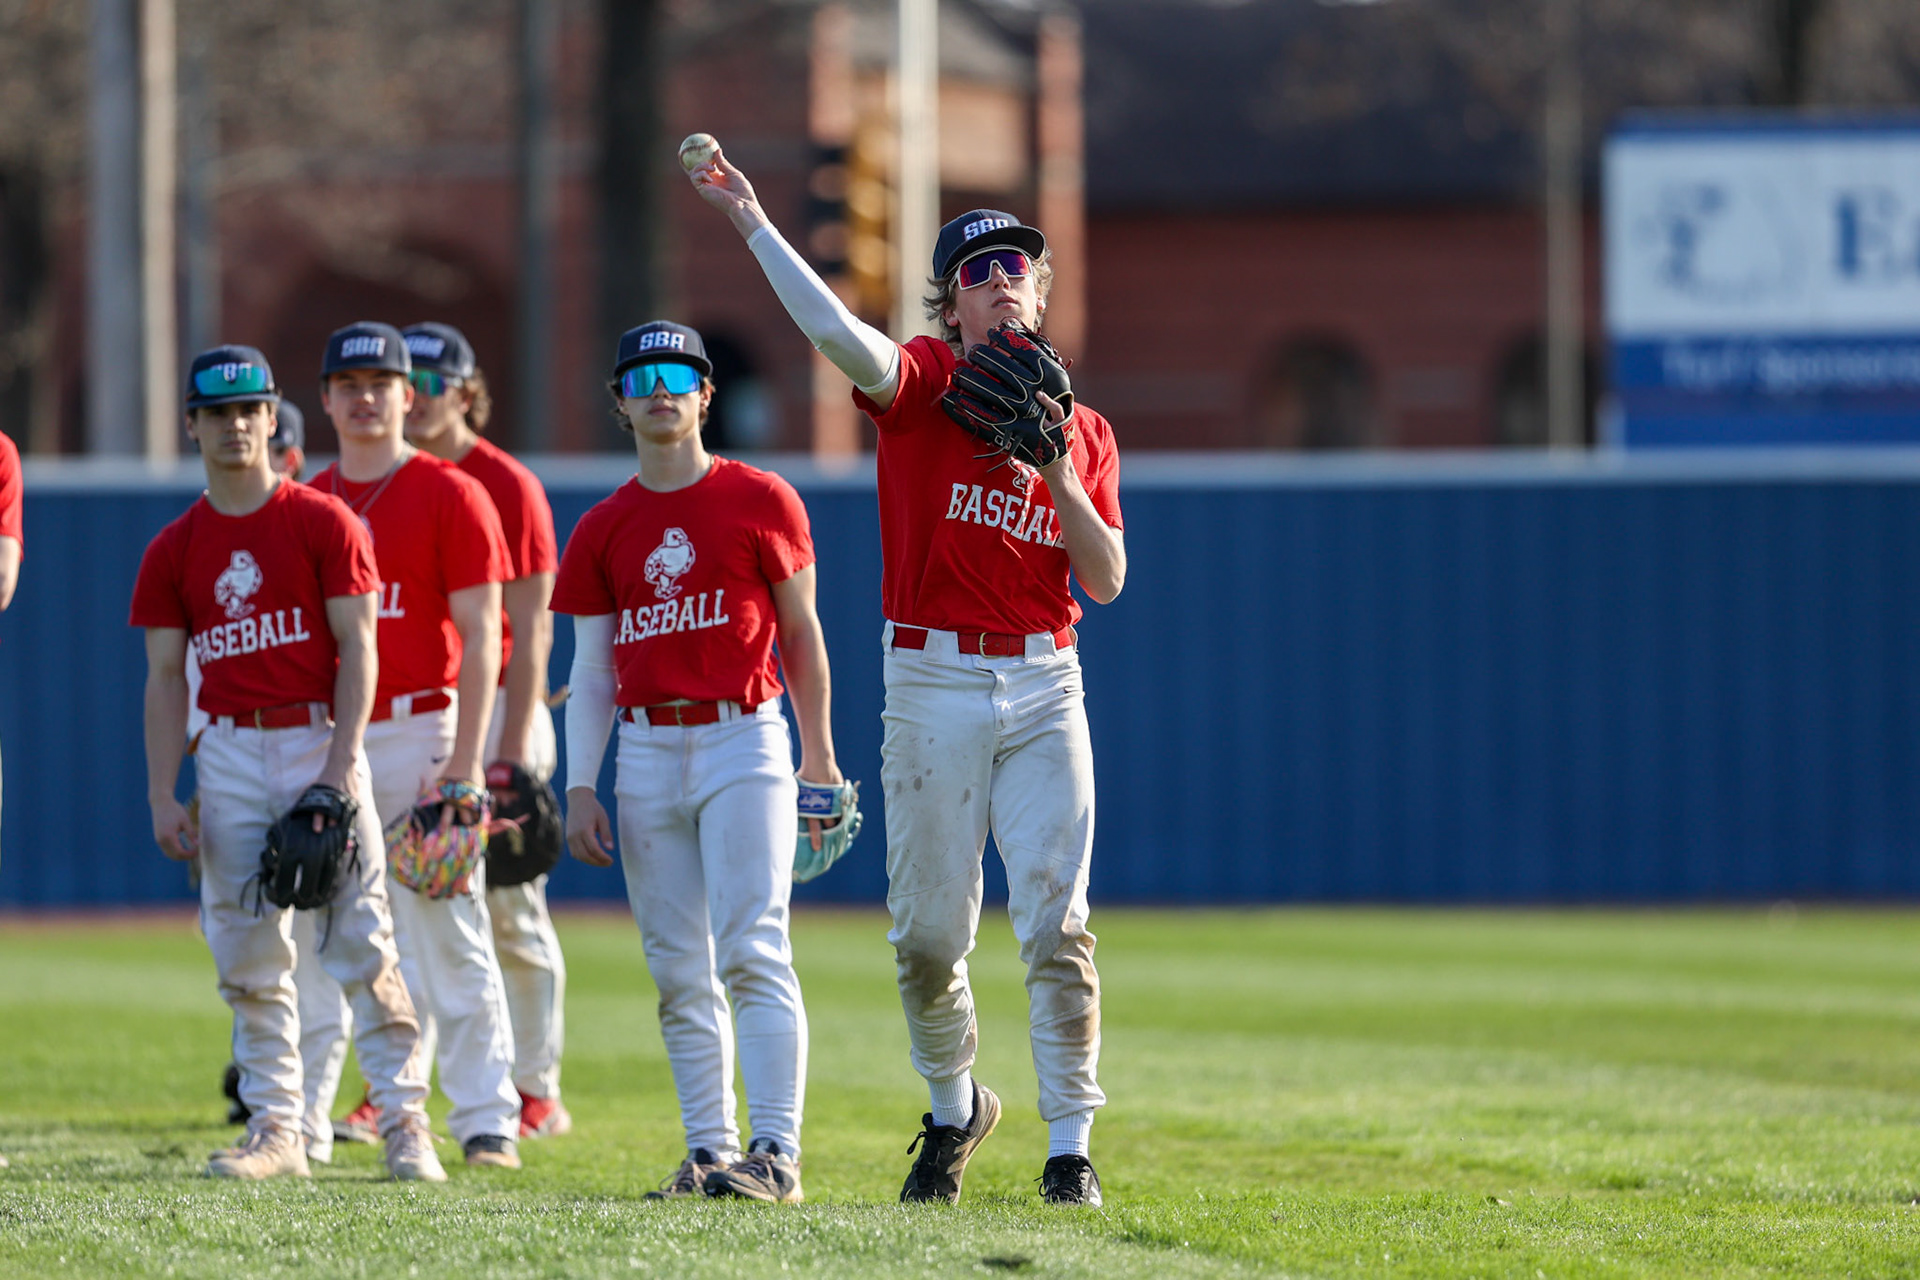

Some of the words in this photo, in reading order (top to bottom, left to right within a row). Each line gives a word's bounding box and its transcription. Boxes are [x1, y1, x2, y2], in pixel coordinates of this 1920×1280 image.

[639, 330, 686, 352] SBA
[945, 483, 1066, 550] BASEAL
[613, 589, 730, 645] ASEBALL
